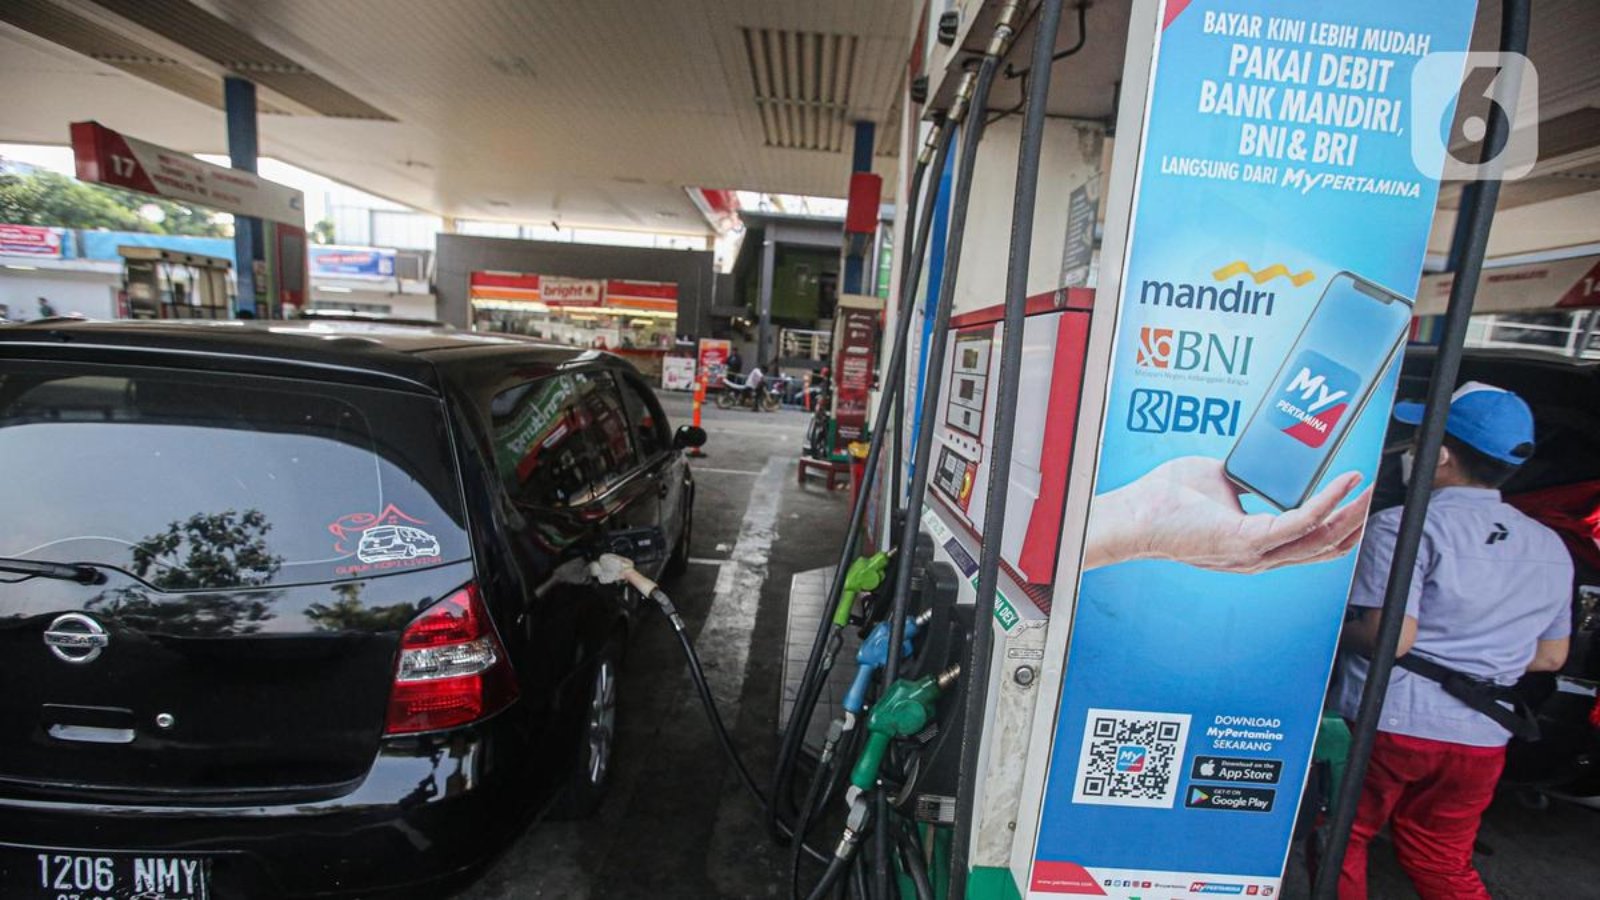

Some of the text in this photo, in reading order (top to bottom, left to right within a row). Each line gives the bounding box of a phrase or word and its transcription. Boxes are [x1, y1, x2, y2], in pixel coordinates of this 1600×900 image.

[1203, 10, 1431, 56] BAYAR KINI LEBIH MUDAH
[1228, 44, 1394, 93] PAKAI DEBIT
[1198, 80, 1404, 137] BANK MANDIRI,
[112, 155, 135, 178] 17
[1311, 133, 1359, 167] BRI
[1161, 156, 1240, 180] LANGSUNG
[1243, 165, 1278, 184] DARI
[543, 283, 584, 298] bright
[1139, 279, 1275, 317] mandiri
[1174, 330, 1254, 376] BNI
[1172, 395, 1241, 437] BRI
[1276, 399, 1329, 433] PERTAMINA
[1206, 727, 1284, 740] MyPertamina
[1215, 715, 1281, 728] DOWNLOAD
[1212, 740, 1272, 751] SEKARANG
[1218, 768, 1273, 780] App Store
[1211, 796, 1268, 809] Google Play
[38, 854, 197, 894] 1206 NMY
